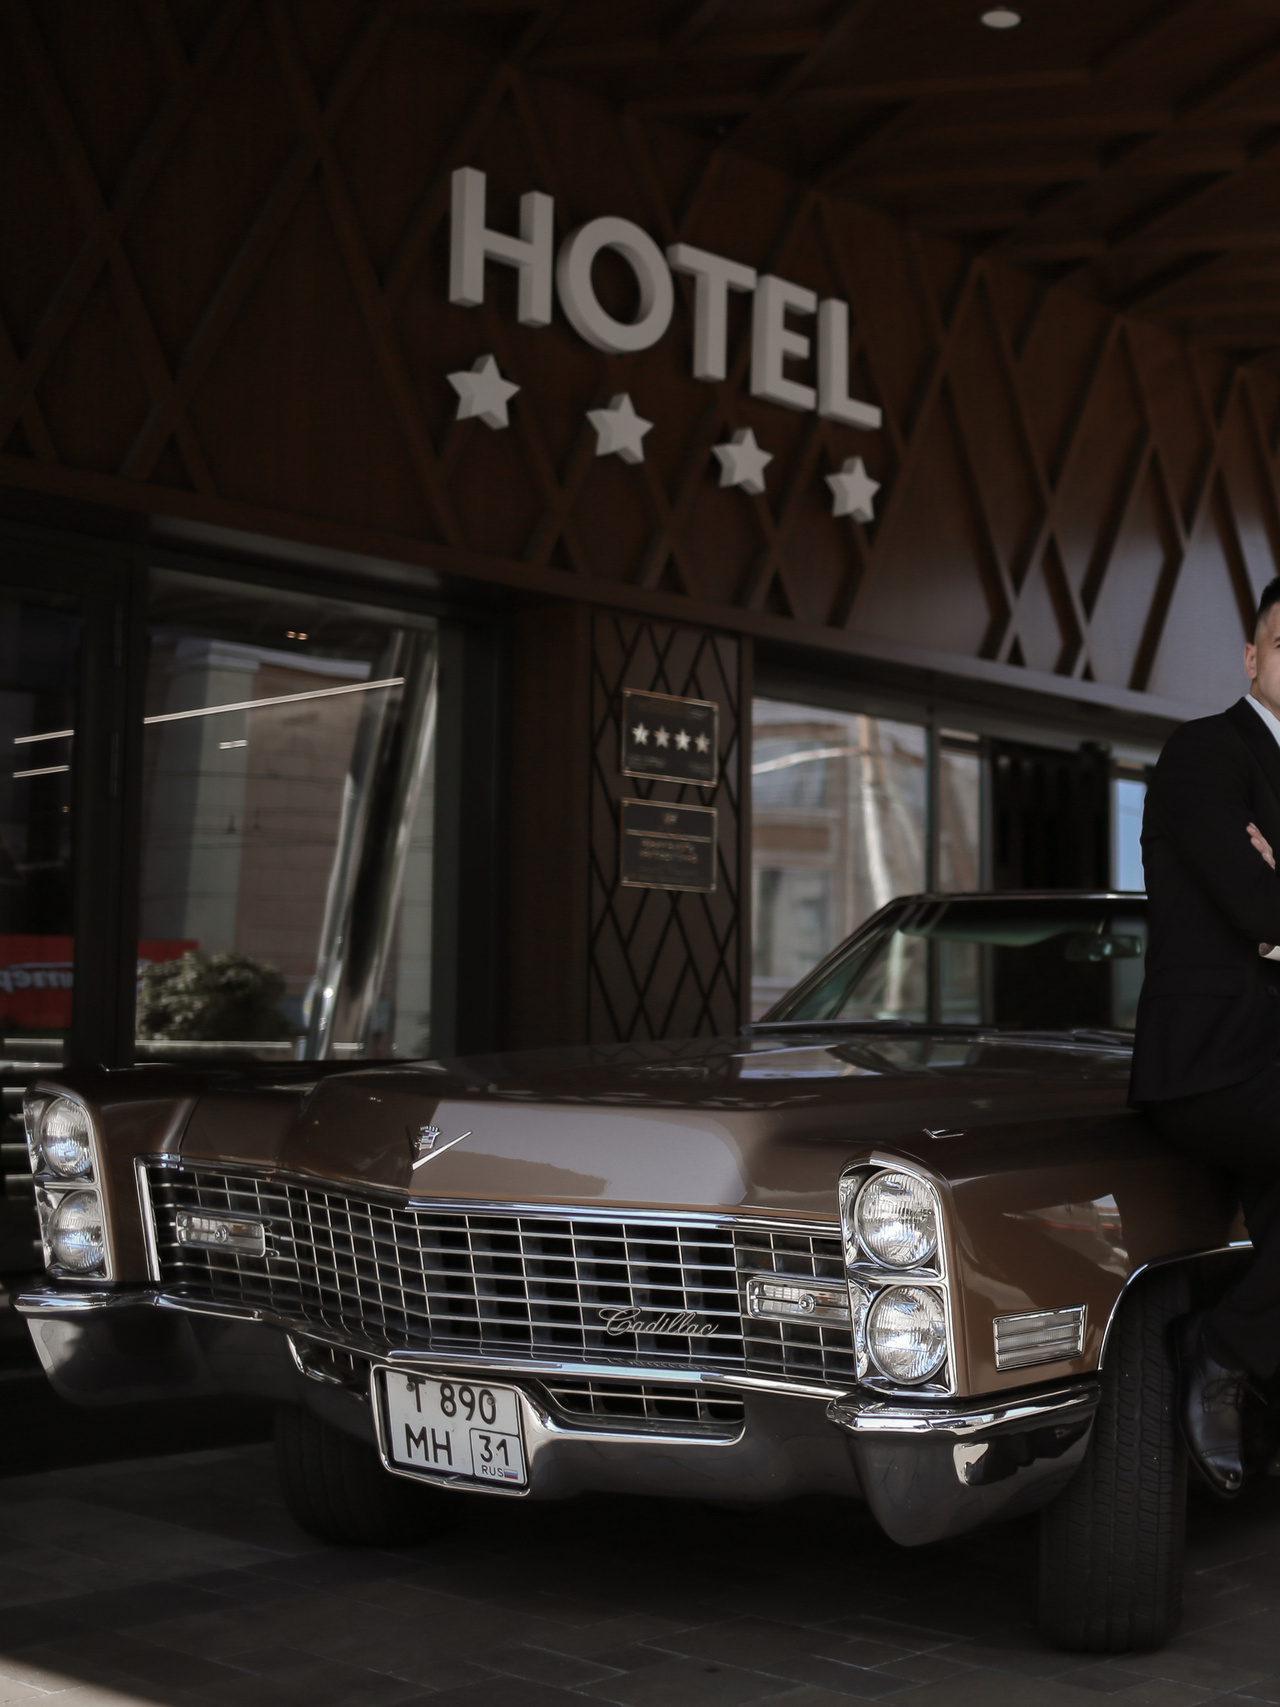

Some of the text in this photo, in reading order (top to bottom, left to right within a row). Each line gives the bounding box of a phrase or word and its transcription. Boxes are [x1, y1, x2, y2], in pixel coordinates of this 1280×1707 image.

[449, 166, 882, 431] HOTEL
[598, 1307, 719, 1336] Cadillac
[407, 1375, 497, 1425] T 890
[404, 1423, 509, 1466] MH 31
[481, 1465, 504, 1477] RUS
